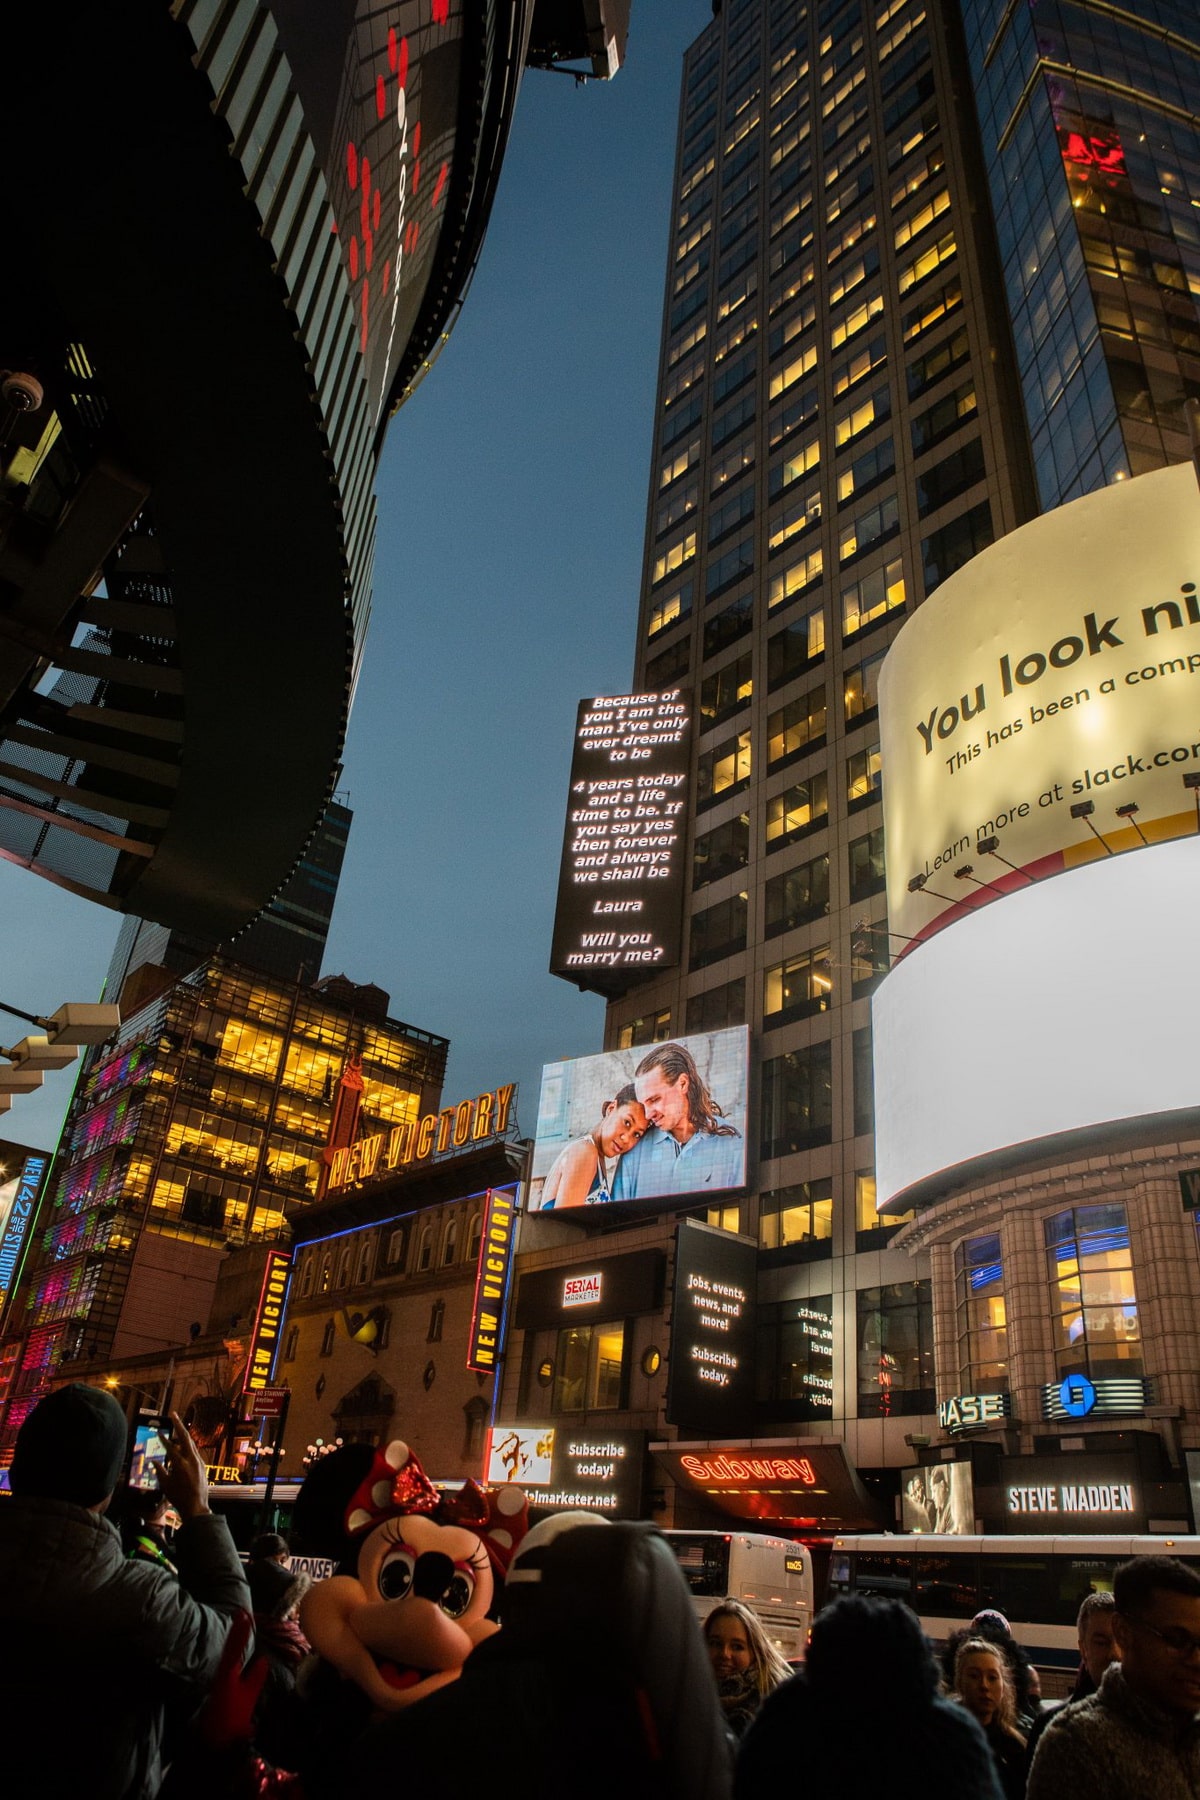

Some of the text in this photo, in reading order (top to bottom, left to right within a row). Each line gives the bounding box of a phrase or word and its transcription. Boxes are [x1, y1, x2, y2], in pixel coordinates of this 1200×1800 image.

[916, 683, 987, 756] You
[1000, 612, 1124, 699] look
[593, 690, 680, 709] Because of
[583, 703, 684, 724] you I am the
[578, 716, 688, 738] man I've only
[945, 743, 982, 776] This
[987, 716, 1023, 749] has
[1030, 688, 1091, 726] been
[1099, 676, 1116, 695] a
[583, 731, 682, 750] ever dreamt
[609, 747, 651, 761] to be
[573, 773, 685, 795] 4 years today
[588, 789, 666, 807] and a life
[571, 801, 684, 822] time to be. If
[576, 819, 674, 838] you say yes
[922, 834, 971, 880] Learn
[976, 800, 1031, 842] more
[1038, 782, 1065, 809] at
[571, 834, 678, 853] then forever
[574, 850, 671, 868] and always
[573, 865, 670, 883] we shall be
[592, 899, 643, 914] Laura
[580, 932, 652, 948] Will you
[566, 947, 664, 965] marry me?
[328, 1083, 516, 1190] NEW VICTORY
[21, 1157, 44, 1187] NEW
[475, 1196, 512, 1365] NEW VICTORY
[688, 1274, 746, 1302] Jobs, events,
[694, 1295, 740, 1316] news, and
[250, 1257, 289, 1389] NEW VICTORY
[701, 1314, 729, 1331] more!
[691, 1346, 738, 1368] Subscribe
[699, 1366, 730, 1386] today.
[568, 1443, 625, 1457] Subscribe
[577, 1462, 615, 1479] today!
[680, 1454, 816, 1485] Subway
[1009, 1484, 1135, 1512] STEVE MADDEN
